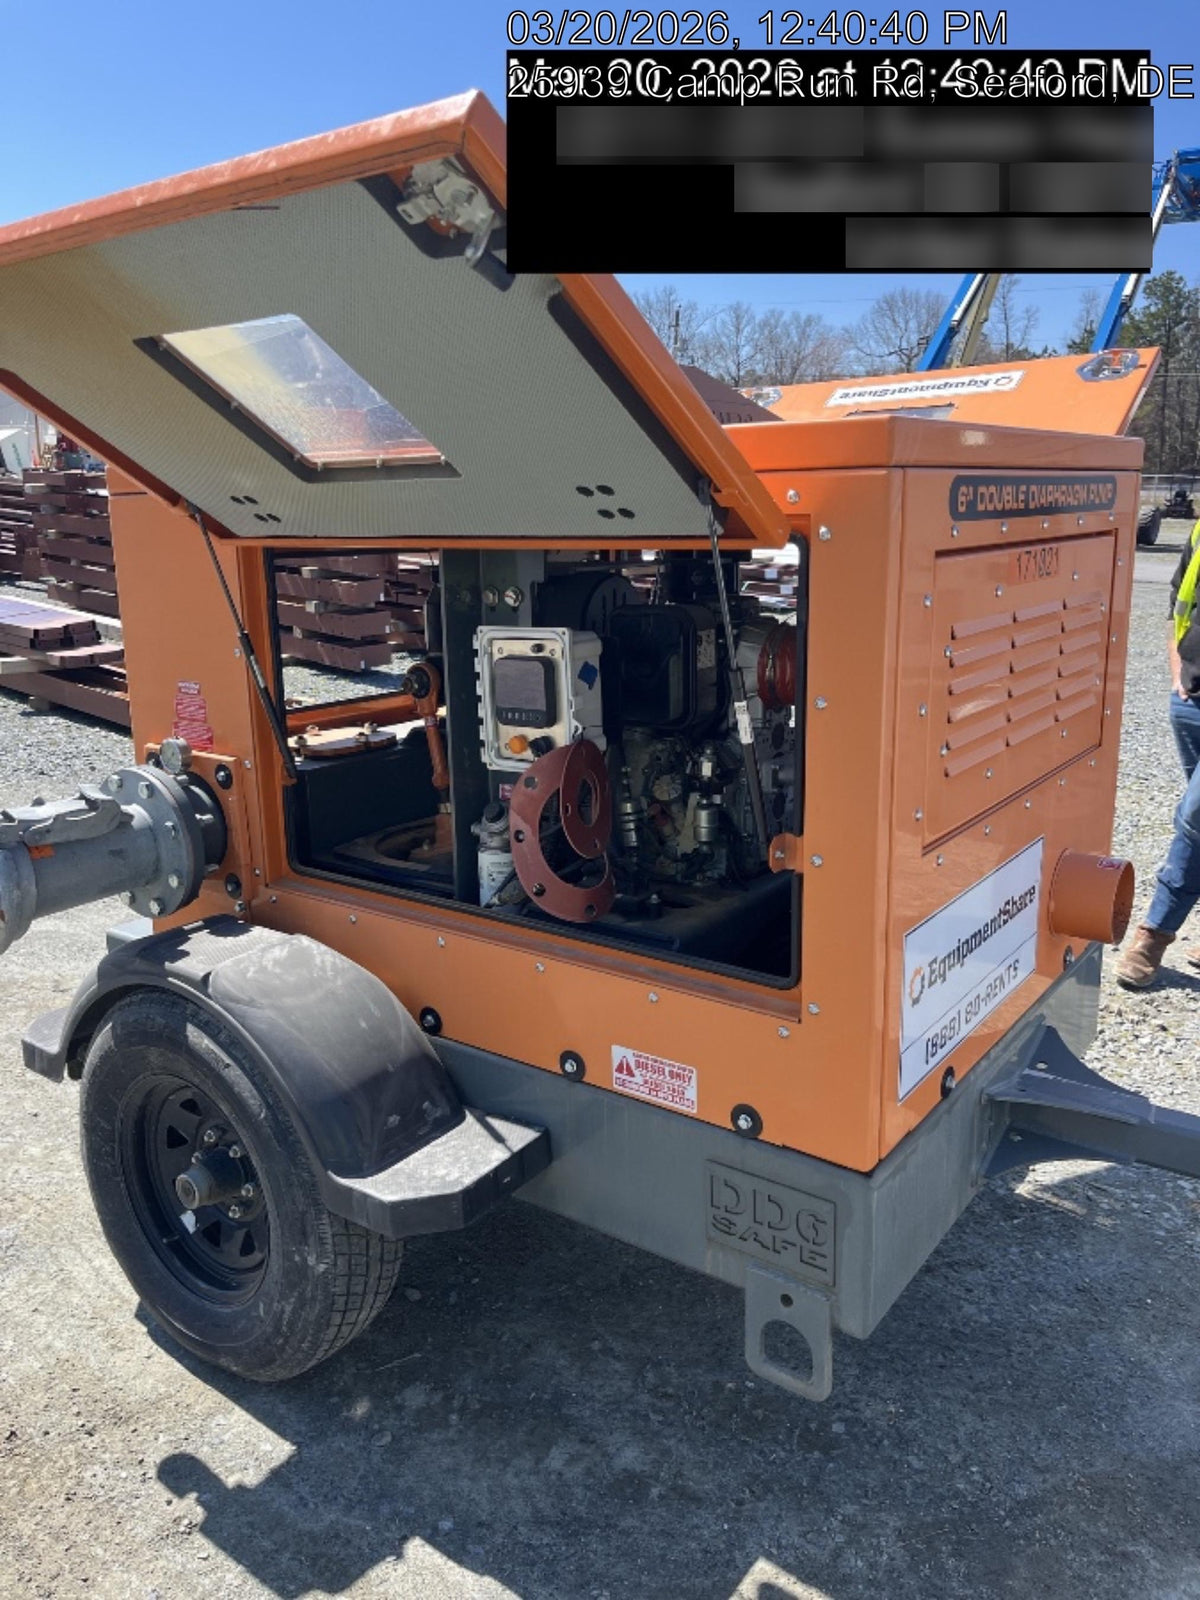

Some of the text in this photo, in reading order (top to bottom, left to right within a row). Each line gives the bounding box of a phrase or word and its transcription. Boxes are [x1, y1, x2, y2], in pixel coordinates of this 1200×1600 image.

[976, 484, 1027, 512] DOUBLE
[926, 884, 1037, 991] EquipmentShare
[710, 1213, 828, 1273] SAFE
